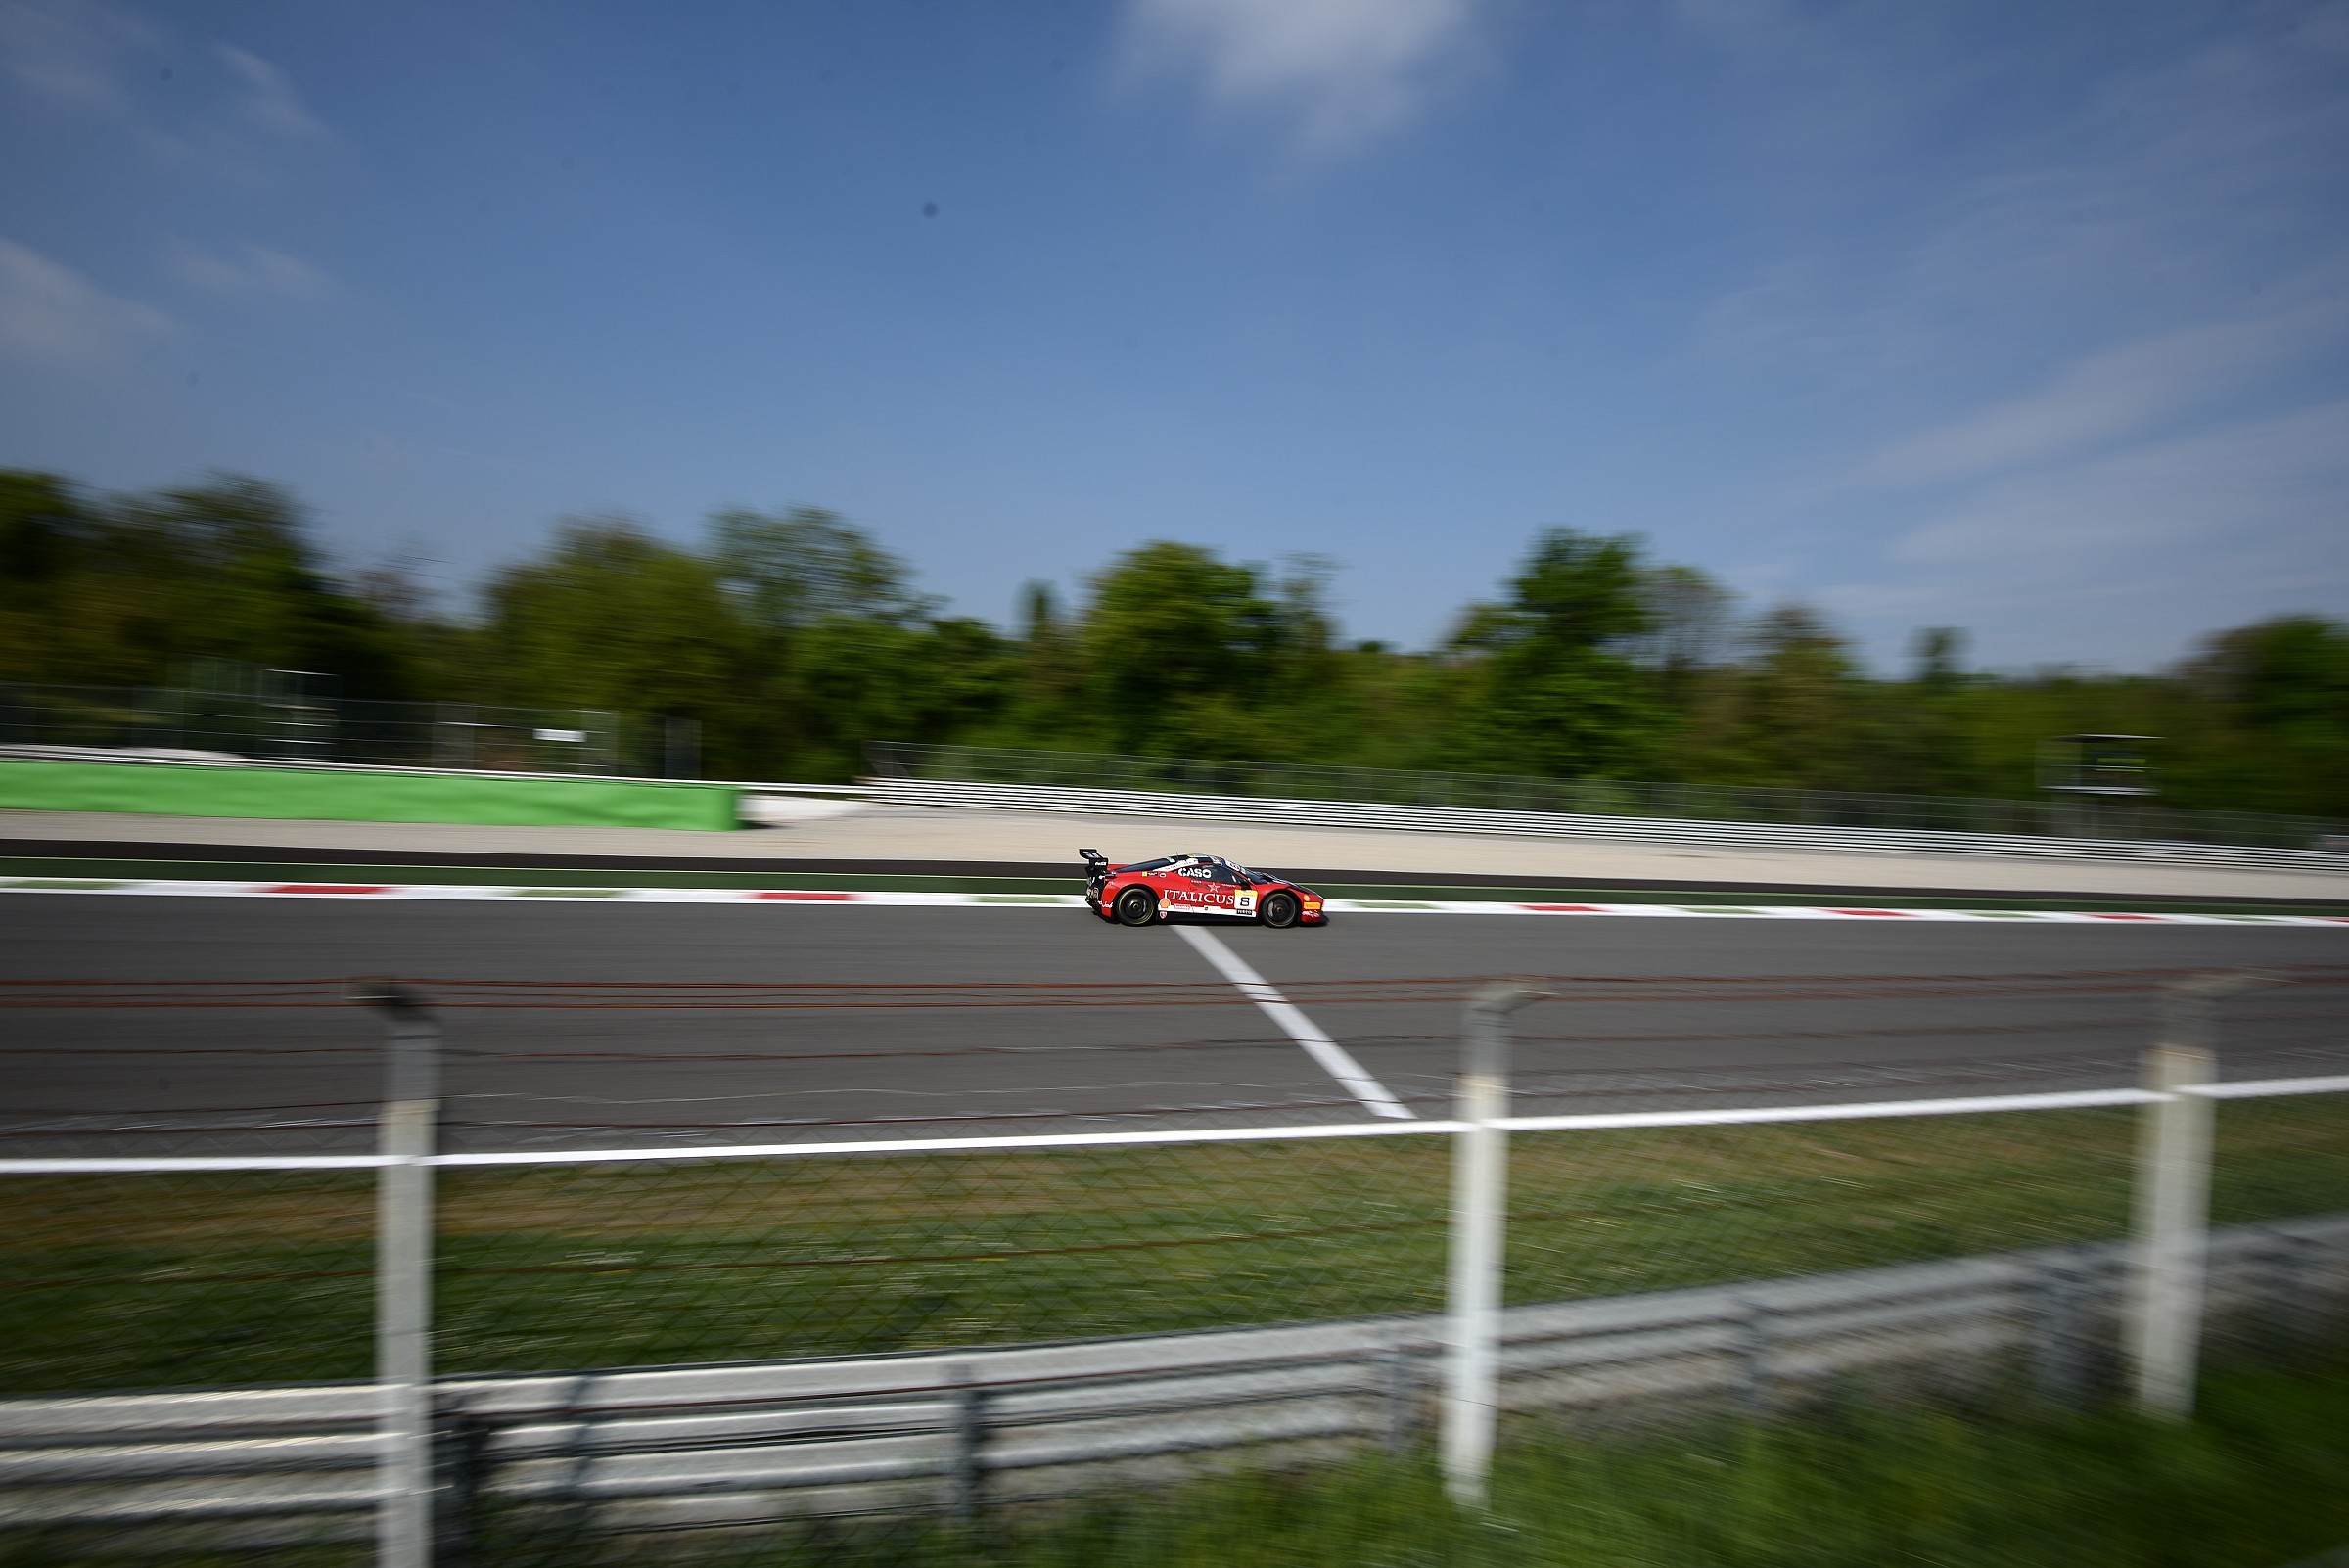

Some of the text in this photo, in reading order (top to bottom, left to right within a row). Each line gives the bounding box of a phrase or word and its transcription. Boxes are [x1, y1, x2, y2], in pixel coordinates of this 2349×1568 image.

[1178, 868, 1212, 878] CASO
[1163, 889, 1234, 905] ITALICUS
[1240, 897, 1250, 906] 8
